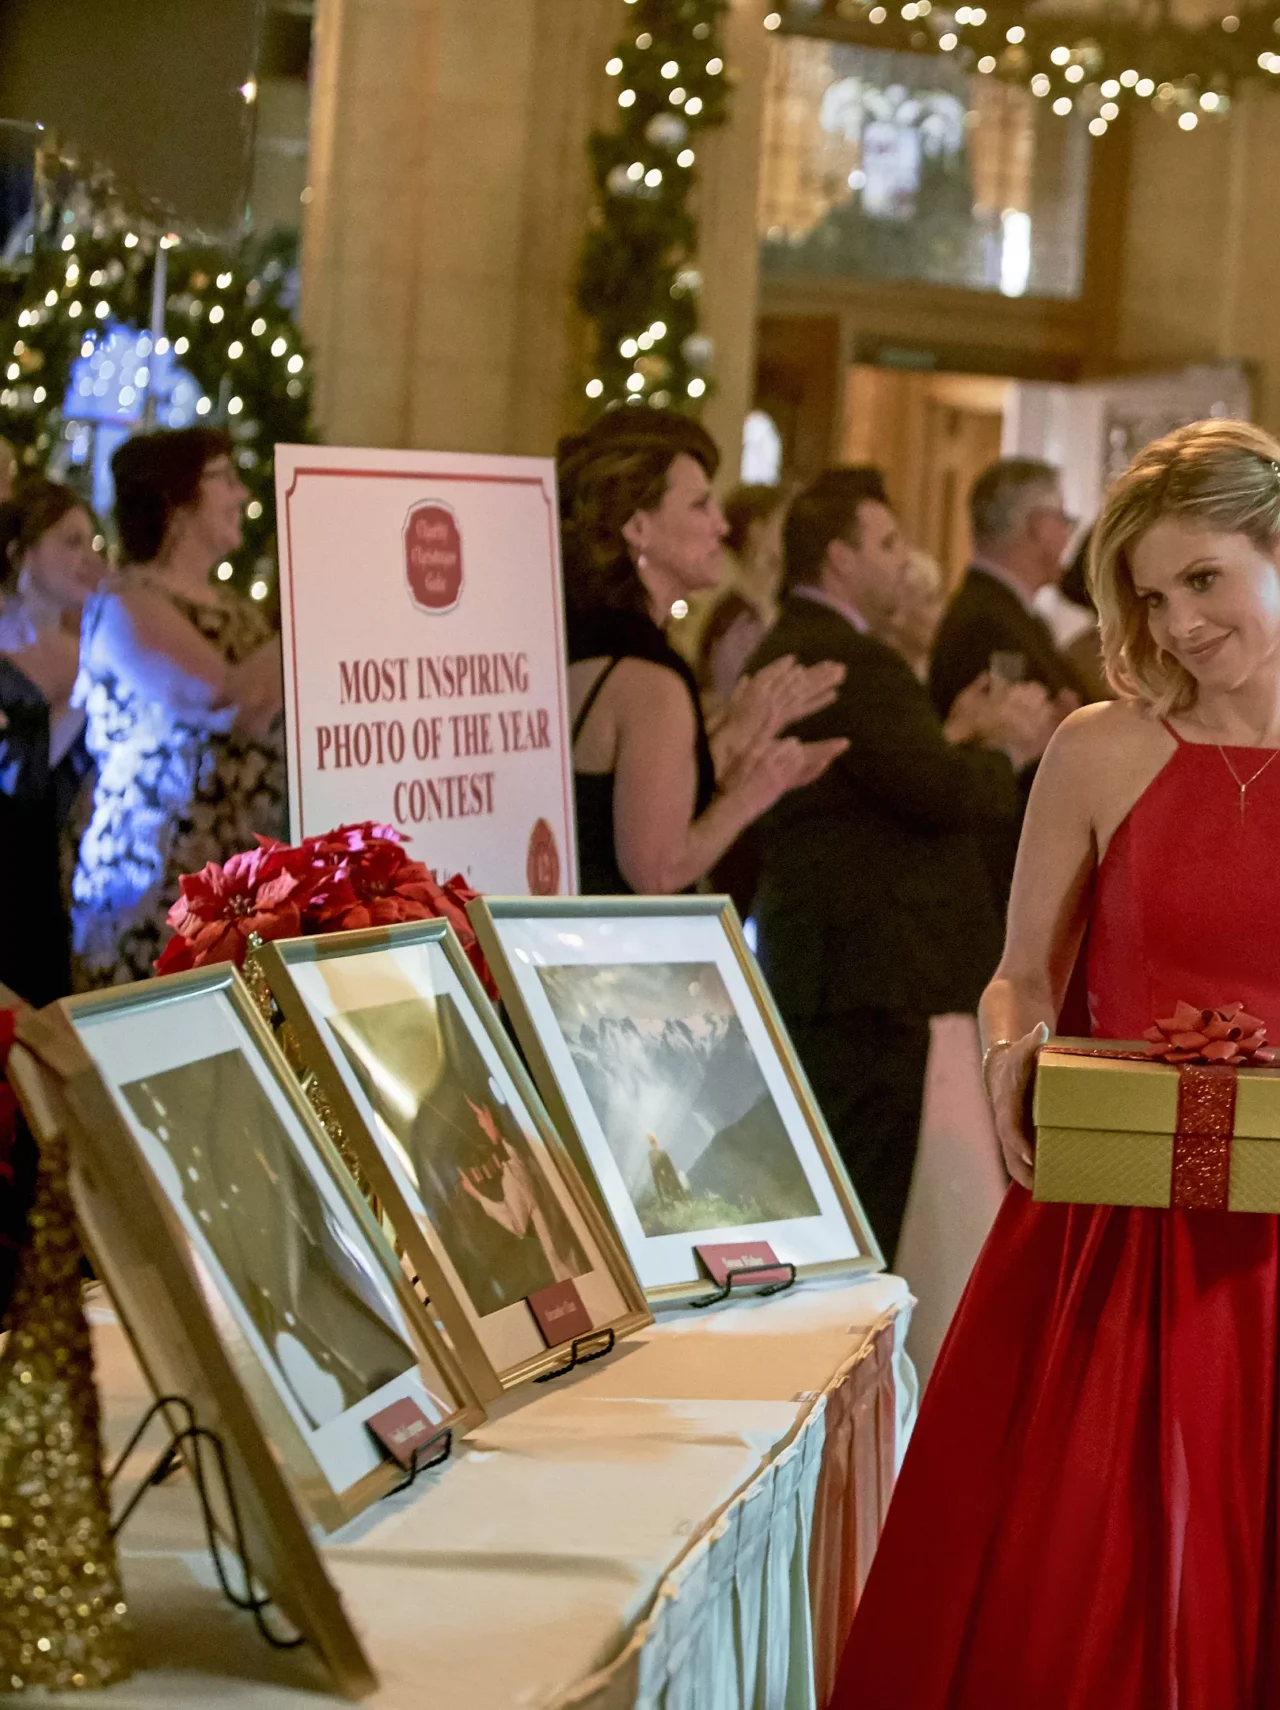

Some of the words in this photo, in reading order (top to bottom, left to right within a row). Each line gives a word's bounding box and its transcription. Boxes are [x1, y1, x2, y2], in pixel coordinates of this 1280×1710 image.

[338, 657, 408, 704] MOST
[417, 652, 529, 699] INSPIRING
[316, 719, 405, 770] PHOTO
[413, 716, 443, 760] OF
[448, 712, 494, 757] THE
[498, 708, 551, 752] YEAR
[393, 771, 494, 824] CONTEST
